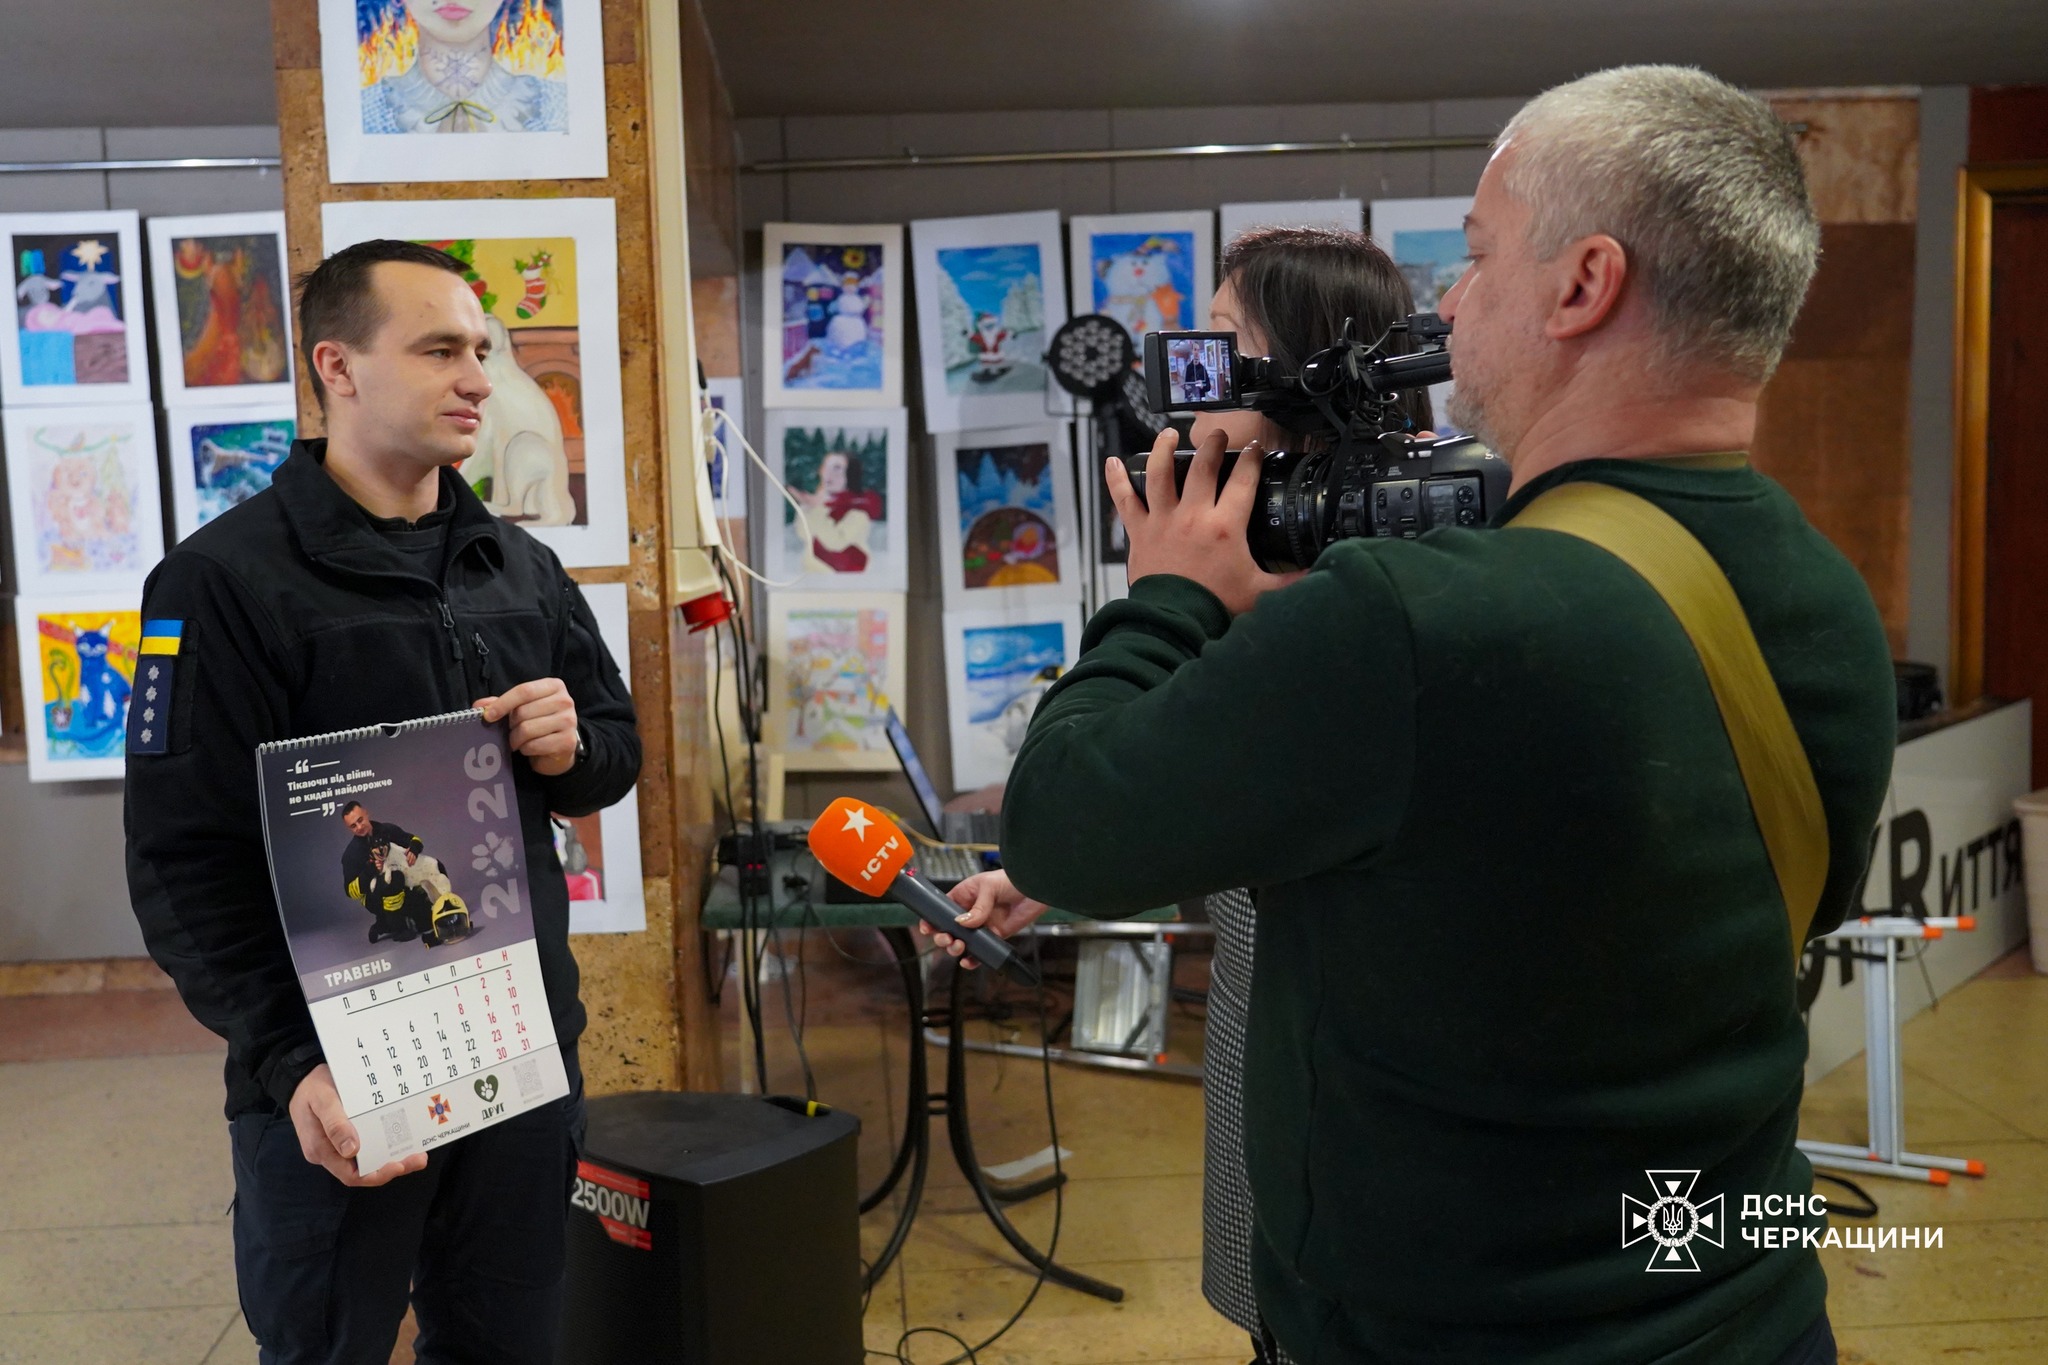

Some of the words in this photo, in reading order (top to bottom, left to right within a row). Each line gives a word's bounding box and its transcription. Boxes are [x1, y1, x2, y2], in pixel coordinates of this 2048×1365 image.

[287, 778, 328, 791] Тікаючи
[330, 773, 345, 784] від
[346, 769, 375, 781] війни,
[289, 796, 302, 805] не
[304, 787, 333, 802] кидай
[334, 778, 393, 796] найдорожче
[860, 835, 899, 881] ICTV
[324, 958, 392, 988] ТРАВЕНЬ
[342, 997, 350, 1009] П
[370, 989, 377, 1001] В
[397, 981, 404, 993] С
[424, 973, 430, 984] Ч
[450, 965, 457, 977] П
[476, 957, 482, 969] С
[502, 950, 508, 961] Н
[454, 985, 459, 997] 1
[480, 977, 487, 989] 2
[505, 969, 512, 981] 3
[357, 1037, 363, 1048] 4
[382, 1029, 390, 1041] 5
[409, 1020, 415, 1033] 6
[433, 1012, 439, 1024] 7
[458, 1003, 464, 1015] 8
[484, 995, 490, 1006] 9
[508, 986, 517, 999] 10
[361, 1055, 371, 1068] 11
[386, 1046, 398, 1059] 12
[412, 1037, 422, 1051] 13
[437, 1029, 447, 1042] 14
[461, 1020, 471, 1033] 15
[487, 1012, 497, 1024] 16
[512, 1003, 520, 1016] 17
[366, 1073, 377, 1086] 18
[393, 1064, 402, 1077] 19
[417, 1055, 429, 1069] 20
[442, 1047, 453, 1060] 21
[465, 1038, 477, 1051] 22
[491, 1029, 502, 1042] 23
[516, 1021, 526, 1034] 24
[372, 1091, 384, 1105] 25
[398, 1082, 409, 1095] 26
[423, 1072, 433, 1086] 27
[447, 1064, 458, 1078] 28
[470, 1055, 481, 1069] 29
[496, 1046, 507, 1060] 30
[521, 1038, 531, 1051] 31
[438, 1122, 470, 1139] ЧЕРКАЩИНИ
[481, 1102, 505, 1121] ДРУГ
[571, 1177, 650, 1229] 2500W
